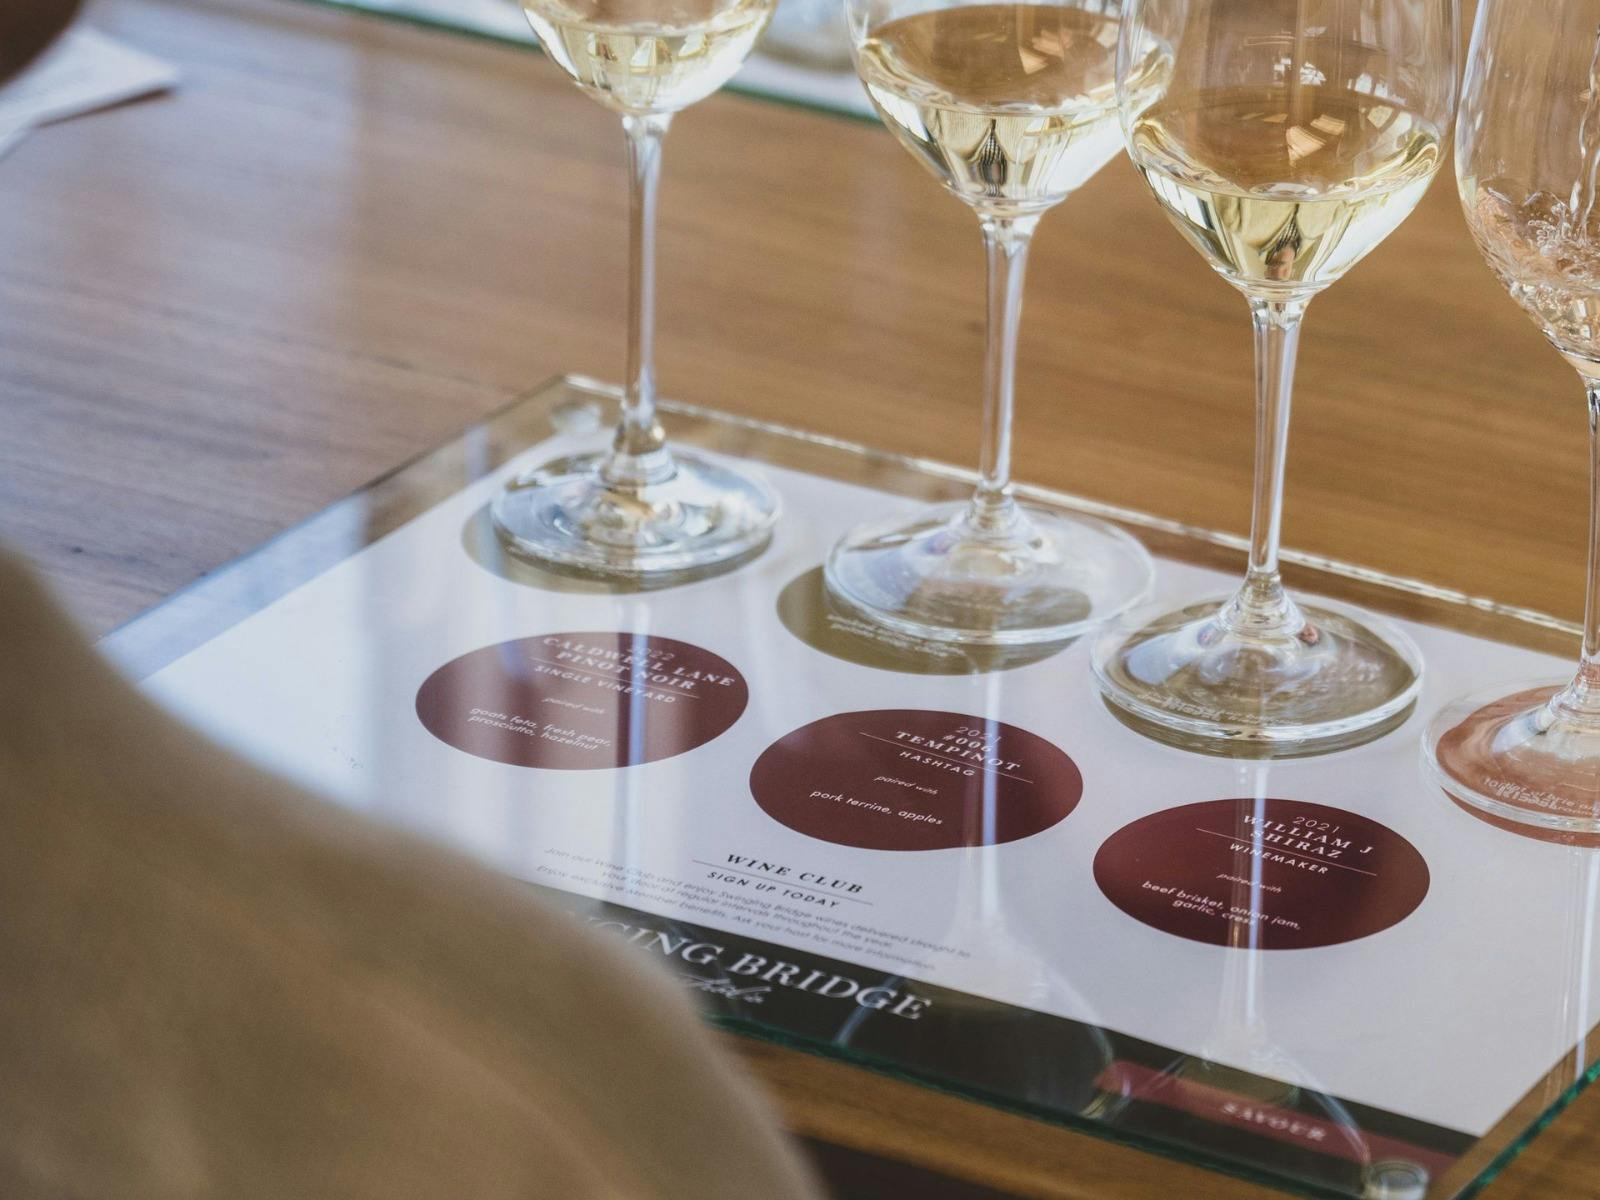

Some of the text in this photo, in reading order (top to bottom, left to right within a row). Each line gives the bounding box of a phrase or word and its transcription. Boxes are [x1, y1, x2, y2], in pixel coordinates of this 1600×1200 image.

[543, 637, 735, 688] CALDWELL LANE
[555, 650, 696, 691] PINOT NOIR
[534, 664, 676, 703] SINGLE VINEYARD
[470, 707, 507, 721] goats
[509, 715, 538, 729] feta,
[543, 723, 576, 738] fresh
[540, 732, 599, 751] hazelnut
[895, 730, 1021, 771] TEMPINOT
[874, 774, 916, 788] paired
[900, 751, 977, 777] HASHTAG
[809, 790, 943, 826] pork terrine, apples
[1292, 816, 1340, 834] 2021
[1242, 814, 1374, 855] WILLIAM J
[1250, 830, 1344, 859] SHIRAZ
[727, 854, 863, 894] WINE CLUB
[1229, 842, 1329, 875] WINEMAKER
[707, 871, 841, 908] SIGN UP TODAY
[1142, 880, 1301, 930] beef brisket, onion jam,
[1172, 899, 1216, 917] garlic,
[726, 953, 932, 1020] BRIDGE
